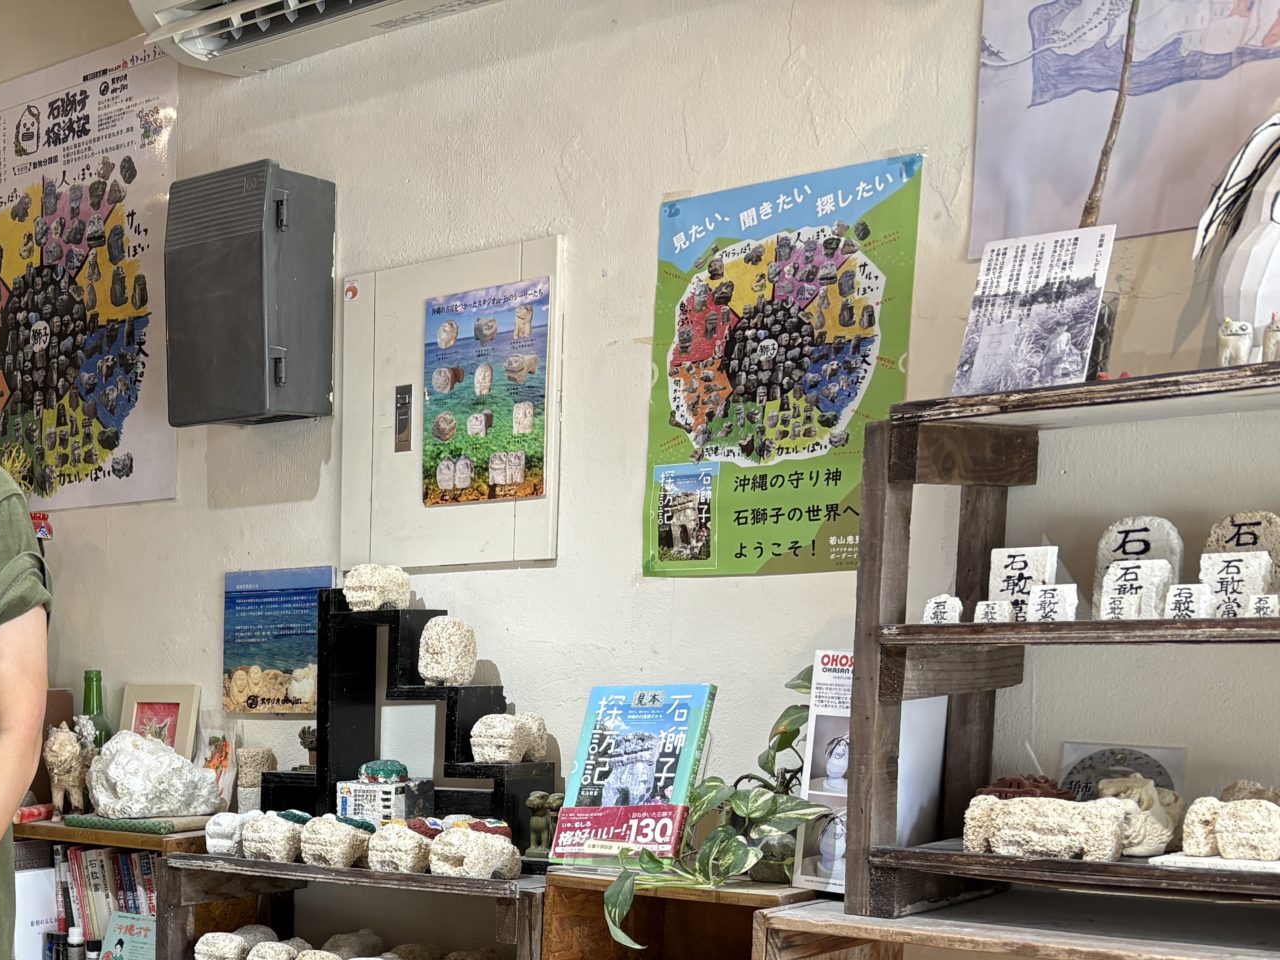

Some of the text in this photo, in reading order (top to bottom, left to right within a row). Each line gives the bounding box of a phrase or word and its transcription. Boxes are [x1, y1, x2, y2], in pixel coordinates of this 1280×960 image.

[48, 90, 90, 120] 石獅子
[672, 212, 730, 253] 見たい、
[739, 184, 812, 230] 聞きたい
[733, 467, 842, 492] 沖縄の守り神
[696, 468, 713, 523] 石獅子
[733, 503, 860, 526] 石獅子の世界へ
[734, 539, 816, 559] ようこそ！
[1114, 565, 1144, 596] 石敢
[930, 601, 949, 624] 石敢
[983, 603, 997, 623] 石敢
[1106, 596, 1124, 620] 石敢
[1254, 597, 1272, 617] 石敢
[636, 693, 661, 706] 見本
[581, 695, 626, 785] 探訪記
[654, 695, 692, 787] 石獅子
[627, 818, 673, 844] 130
